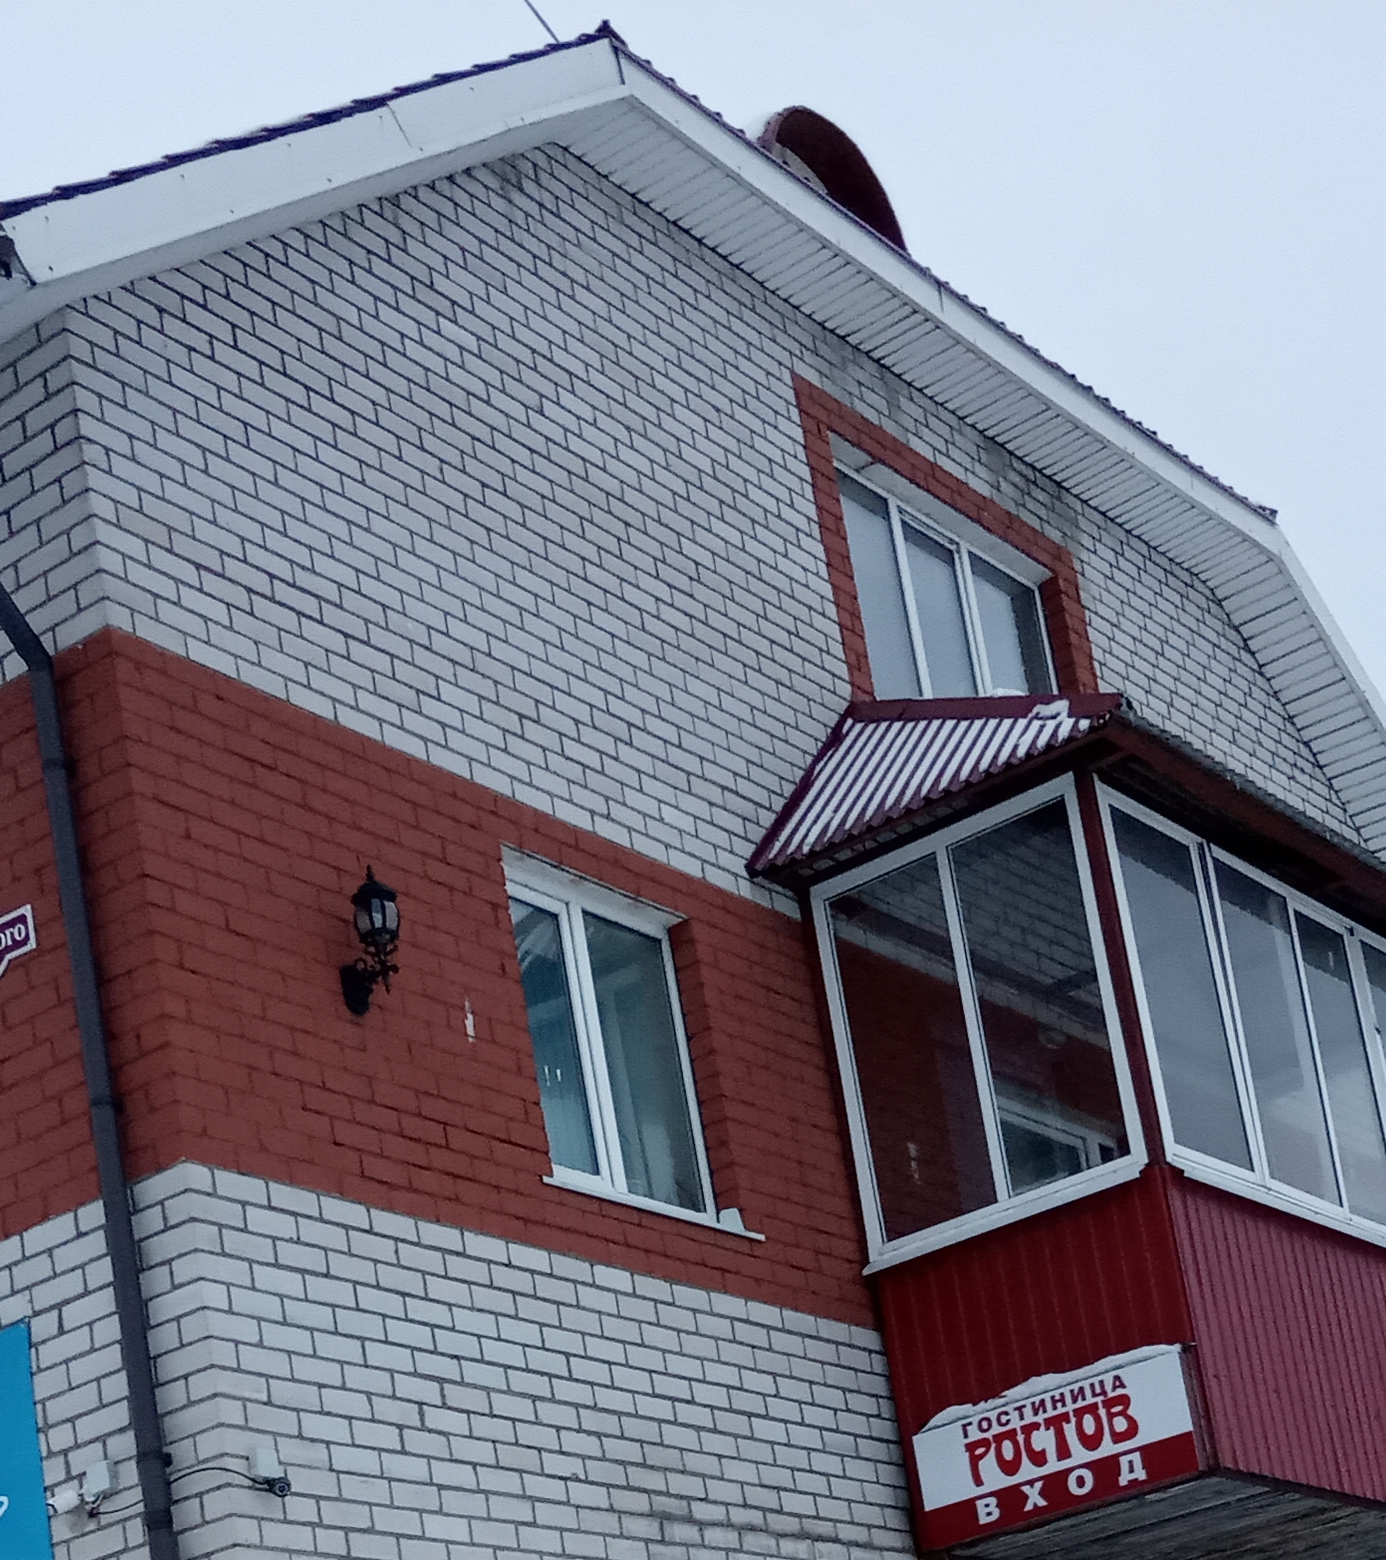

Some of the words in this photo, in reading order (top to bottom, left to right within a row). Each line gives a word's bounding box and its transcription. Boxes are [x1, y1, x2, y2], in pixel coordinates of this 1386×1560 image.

[961, 1374, 1127, 1439] ГОСТИНИЦА
[964, 1393, 1139, 1487] РОСТОВ
[975, 1451, 1147, 1525] ВХОД
